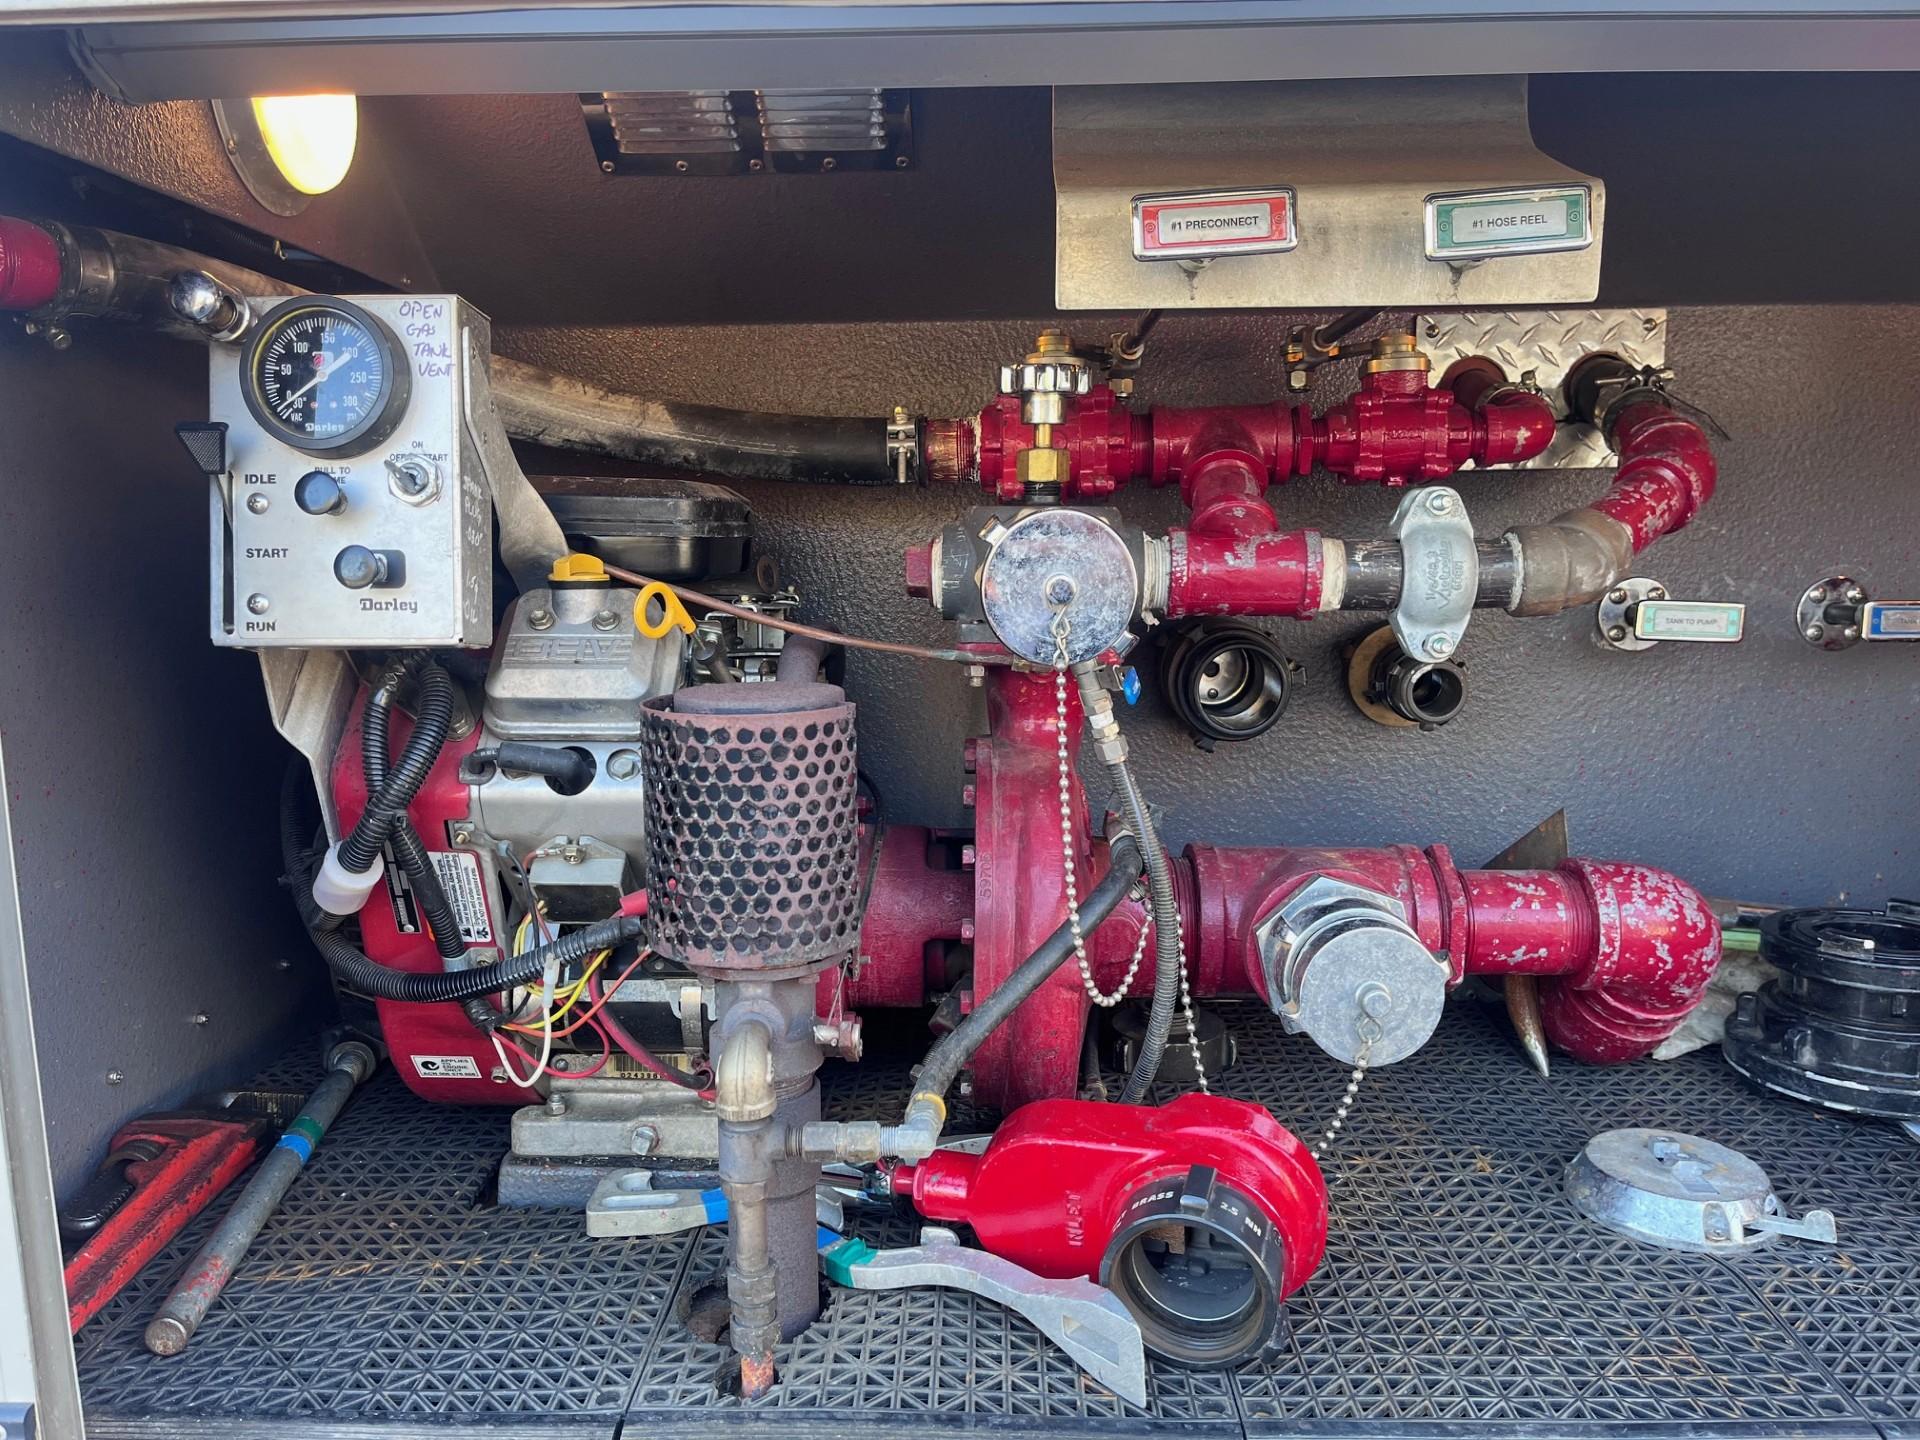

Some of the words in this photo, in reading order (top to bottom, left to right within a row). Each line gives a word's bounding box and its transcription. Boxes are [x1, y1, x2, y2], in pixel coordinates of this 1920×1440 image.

[1171, 222, 1182, 230] #1
[1185, 216, 1259, 230] PRECONNECT
[1472, 220, 1483, 229] #1
[1487, 216, 1517, 228] HOSE
[1520, 214, 1548, 226] REEL
[399, 301, 442, 319] OPEN
[406, 323, 436, 338] GAS
[320, 333, 336, 344] 150
[293, 343, 308, 353] 100
[414, 342, 452, 358] TANK
[281, 364, 292, 375] 50
[418, 362, 456, 376] VENT
[350, 372, 366, 383] 250
[343, 396, 358, 406] 300
[290, 413, 302, 422] VAC
[305, 423, 344, 432] Darley
[411, 440, 424, 448] ON
[244, 474, 276, 484] IDLE
[246, 548, 288, 559] START
[360, 598, 418, 614] Darley
[246, 622, 276, 632] RUN
[1696, 618, 1718, 626] PUMP
[1132, 1191, 1175, 1210] BRASS
[1220, 1202, 1239, 1216] 2.5
